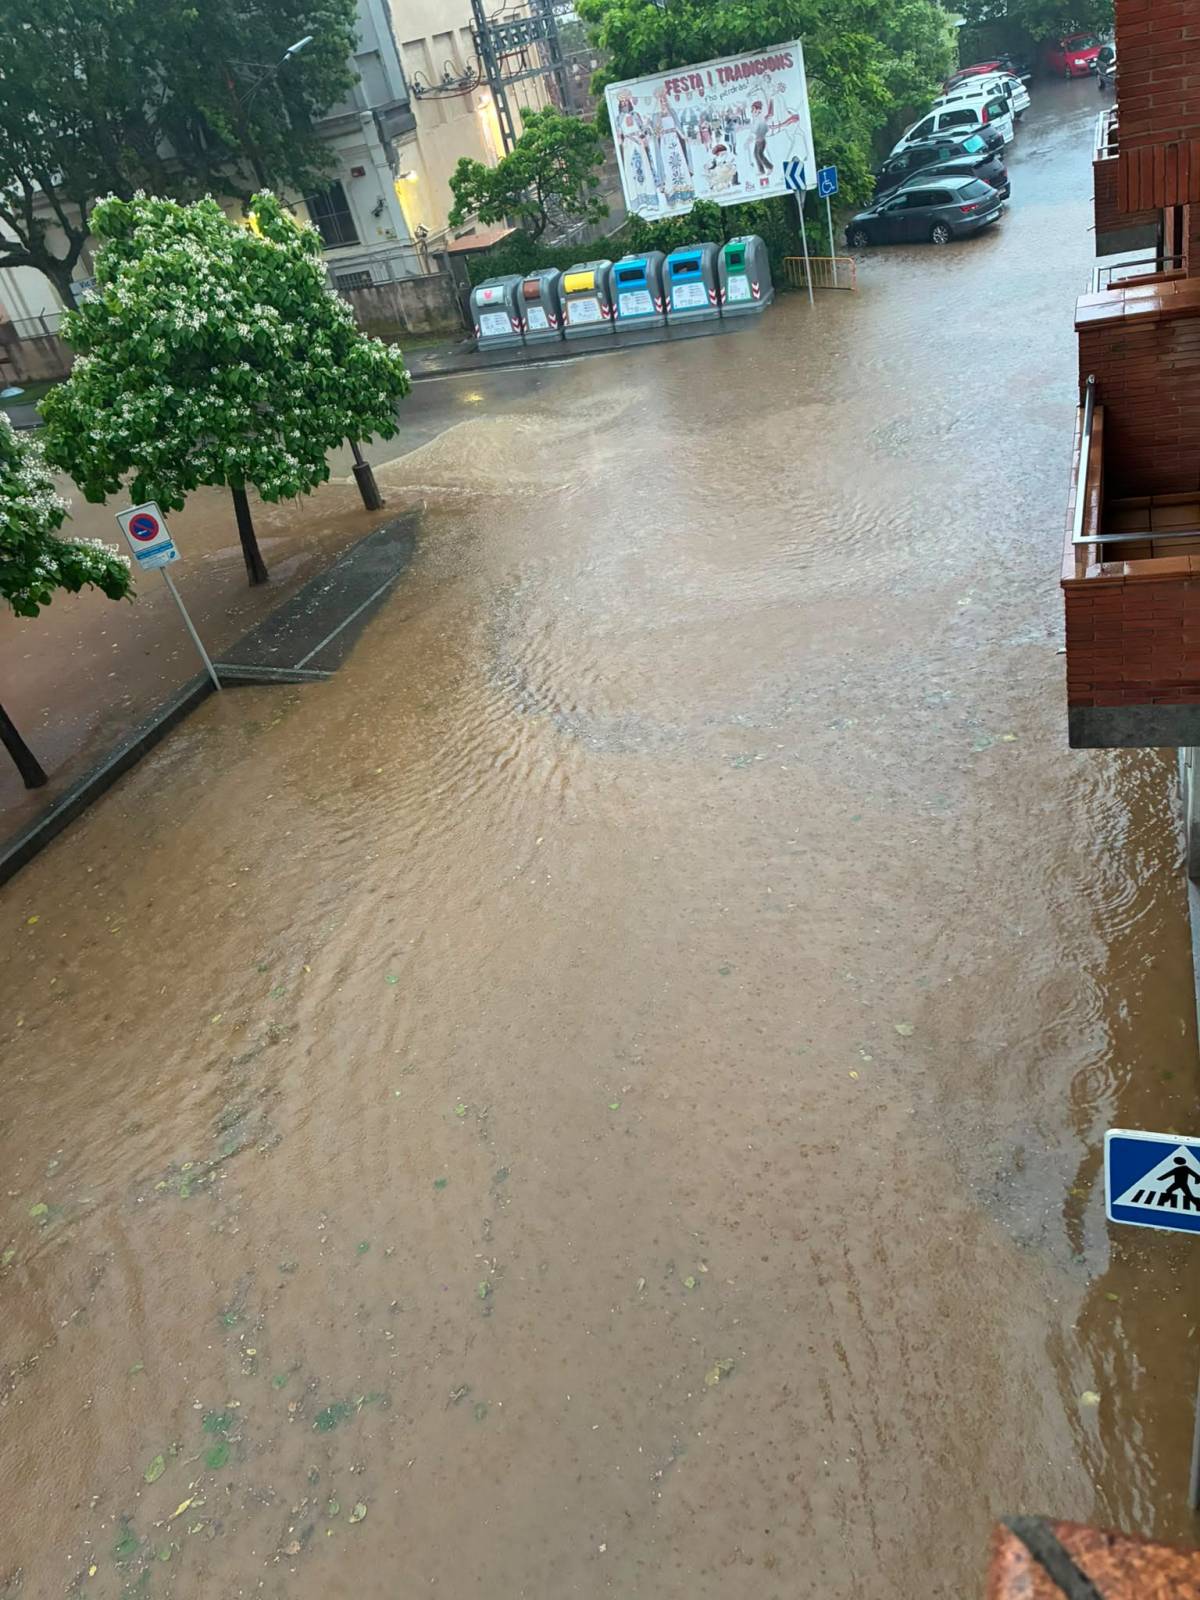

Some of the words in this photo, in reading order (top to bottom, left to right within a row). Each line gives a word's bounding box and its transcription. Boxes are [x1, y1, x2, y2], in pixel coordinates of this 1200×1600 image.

[664, 73, 704, 96] FESTA
[706, 70, 713, 87] I
[716, 52, 794, 84] TRADICIONS
